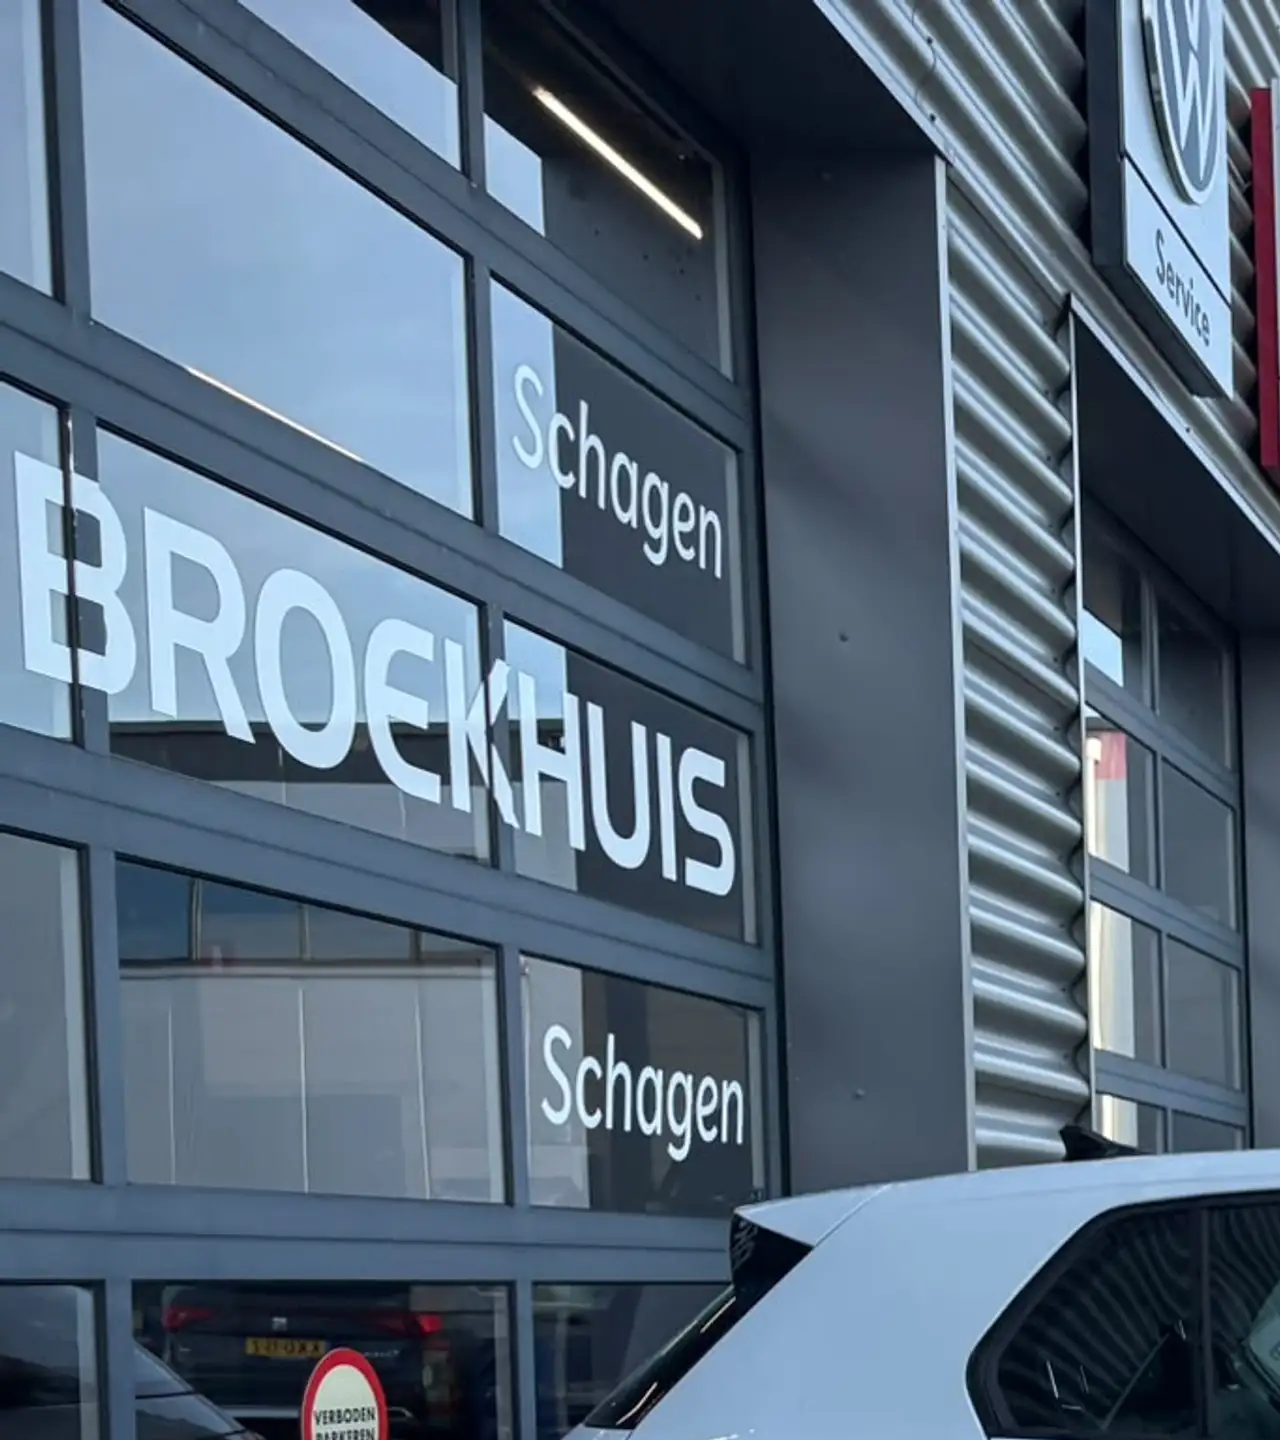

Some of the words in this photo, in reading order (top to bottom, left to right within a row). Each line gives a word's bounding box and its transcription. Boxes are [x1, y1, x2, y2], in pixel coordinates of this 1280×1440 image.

[1155, 228, 1210, 347] Service
[512, 364, 722, 579] Schagen
[14, 449, 737, 897] BROEKHUIS
[540, 1024, 744, 1161] Schagen
[314, 1406, 376, 1426] VERBODEN
